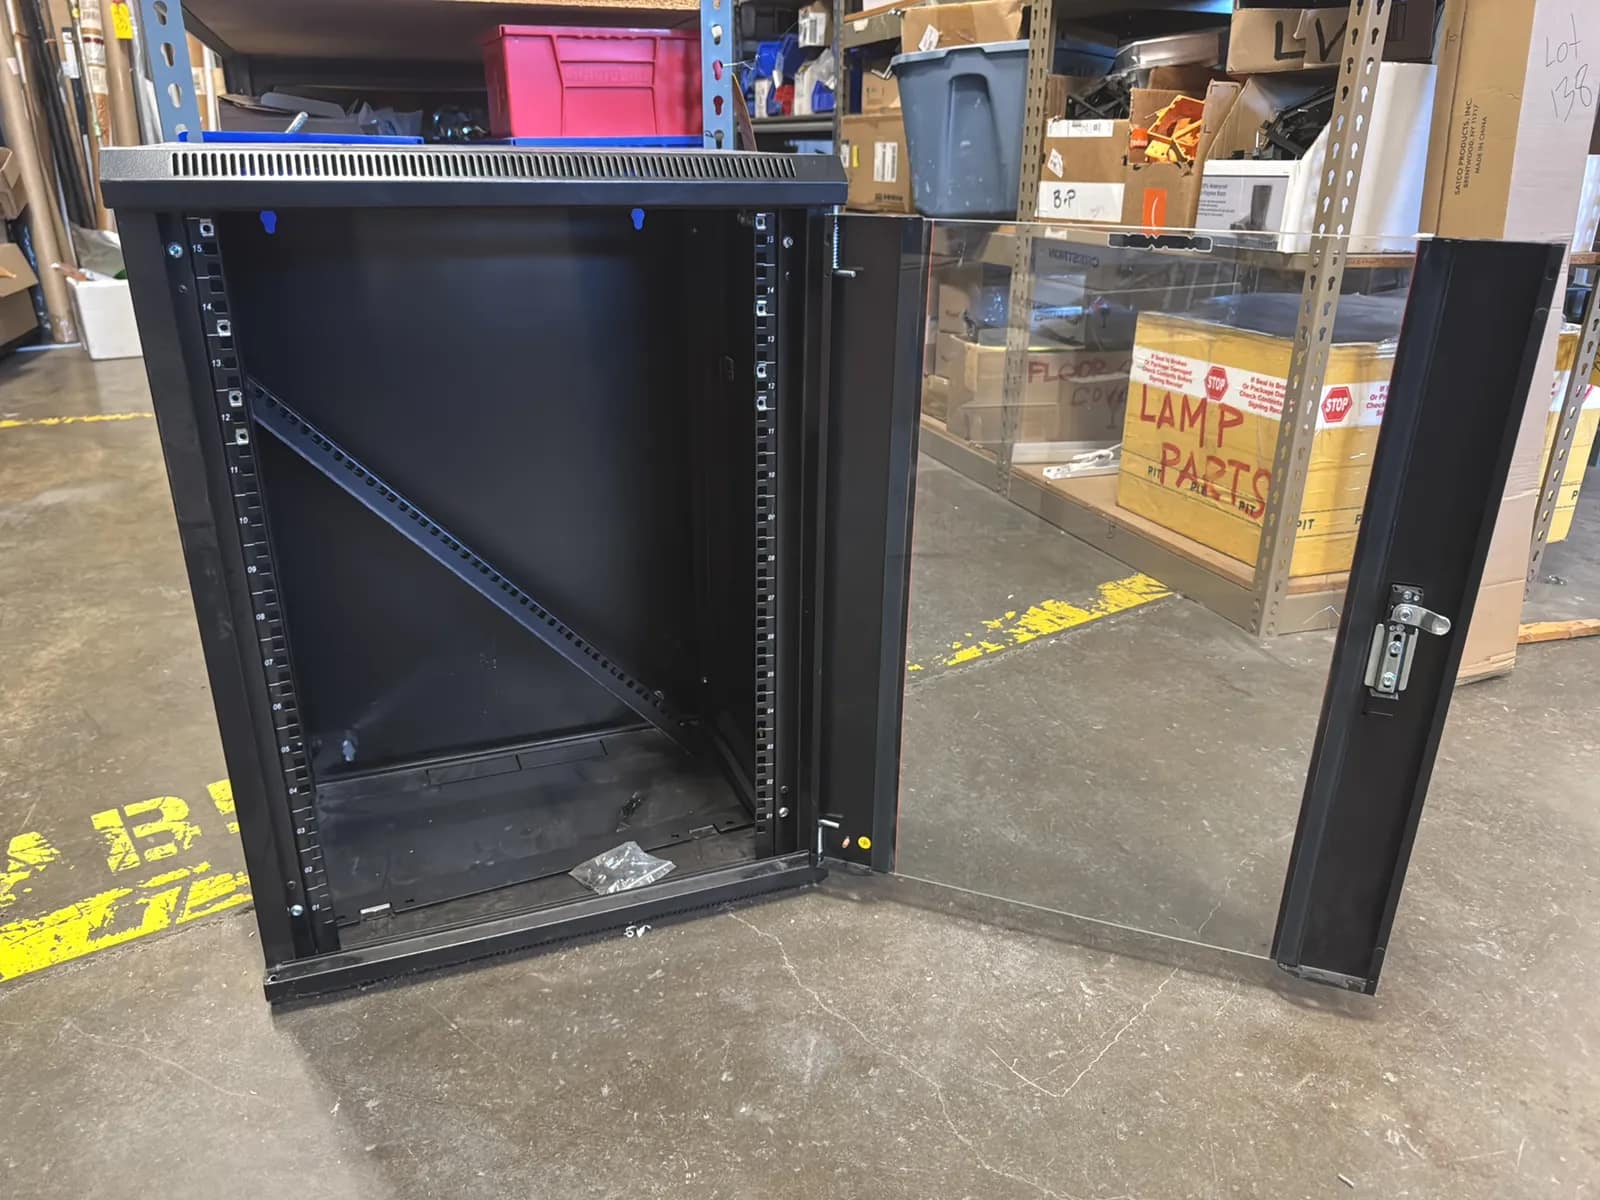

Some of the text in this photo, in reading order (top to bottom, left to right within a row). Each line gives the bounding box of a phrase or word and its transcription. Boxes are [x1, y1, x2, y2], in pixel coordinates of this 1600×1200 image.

[1545, 12, 1582, 68] Lot
[1550, 63, 1593, 123] 138
[1478, 116, 1488, 141] CHINA
[1454, 168, 1464, 196] SATCO
[192, 244, 202, 253] 15
[202, 303, 212, 311] 14
[212, 359, 222, 368] 13
[1207, 376, 1225, 391] STOP
[1239, 390, 1256, 399] Check
[1250, 384, 1273, 396] Package
[1325, 397, 1348, 412] STOP
[221, 413, 231, 421] 12
[1140, 384, 1244, 449] LAMP
[230, 466, 239, 474] 11
[1160, 442, 1273, 520] PARTS
[239, 516, 249, 525] 10
[247, 566, 257, 574] 09
[264, 658, 274, 666] 07
